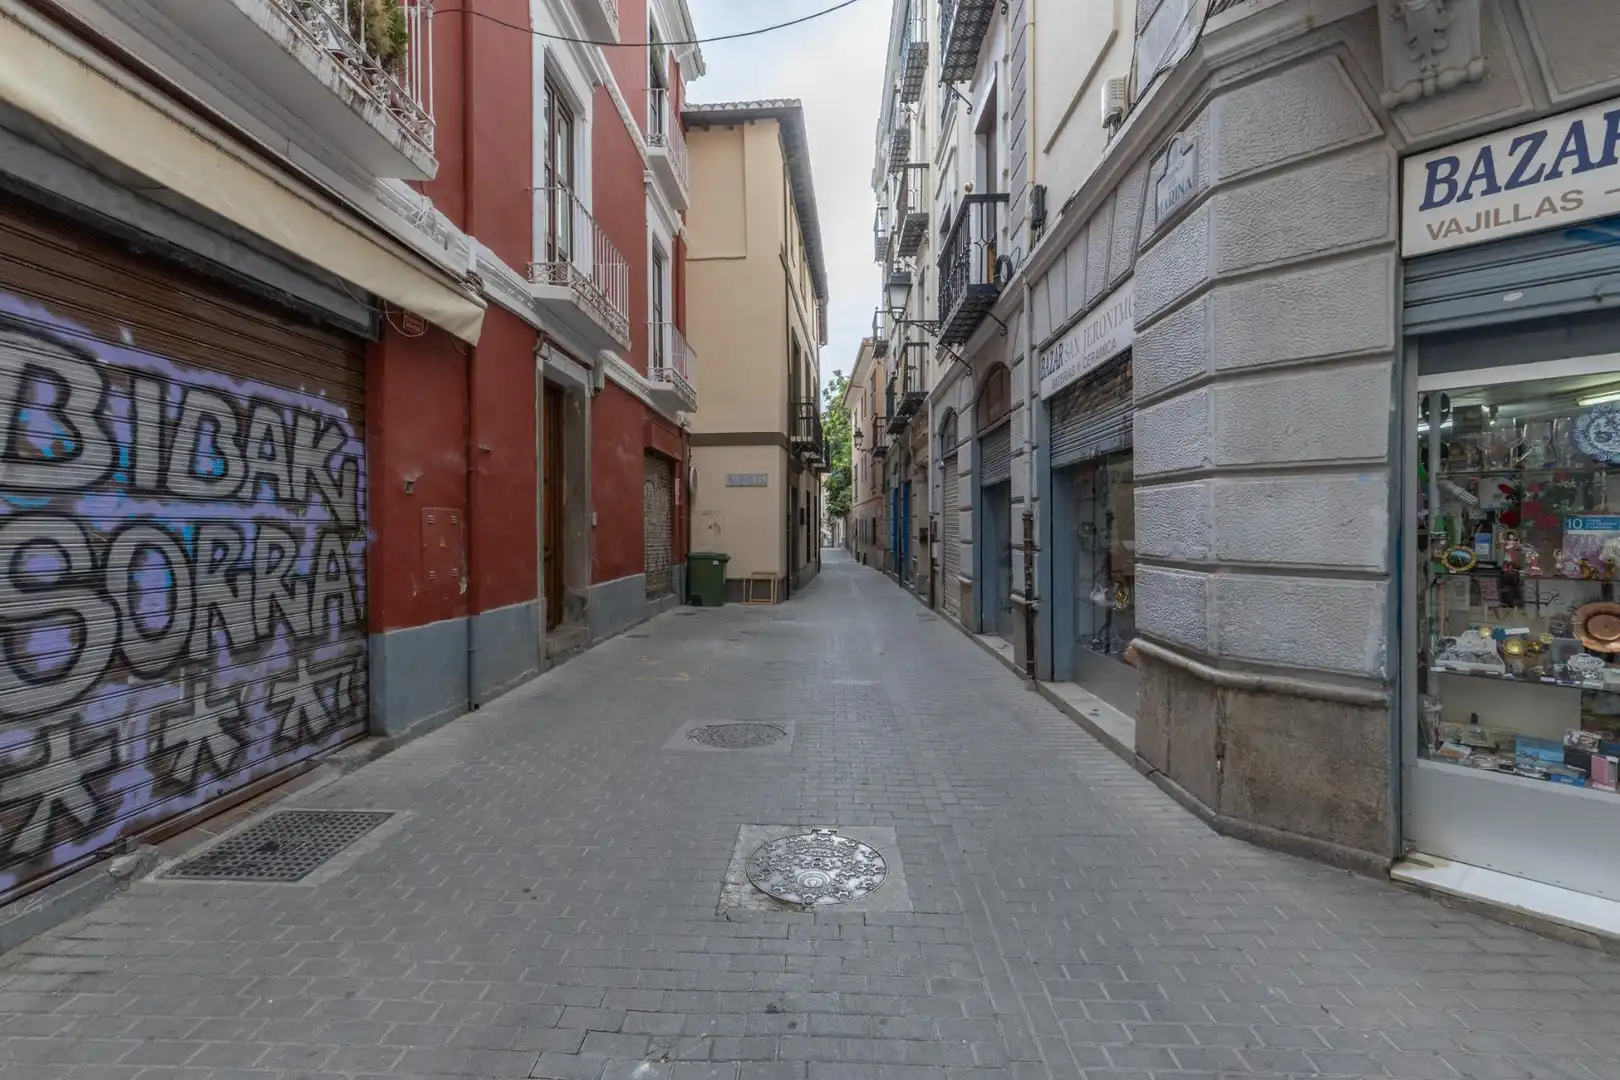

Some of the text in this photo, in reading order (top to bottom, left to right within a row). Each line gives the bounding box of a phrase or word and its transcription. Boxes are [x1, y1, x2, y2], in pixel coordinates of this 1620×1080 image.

[1426, 189, 1585, 241] VAJILLAS
[1040, 343, 1063, 381] BAZAR
[1064, 335, 1080, 363] SAN
[1565, 518, 1583, 530] 10
